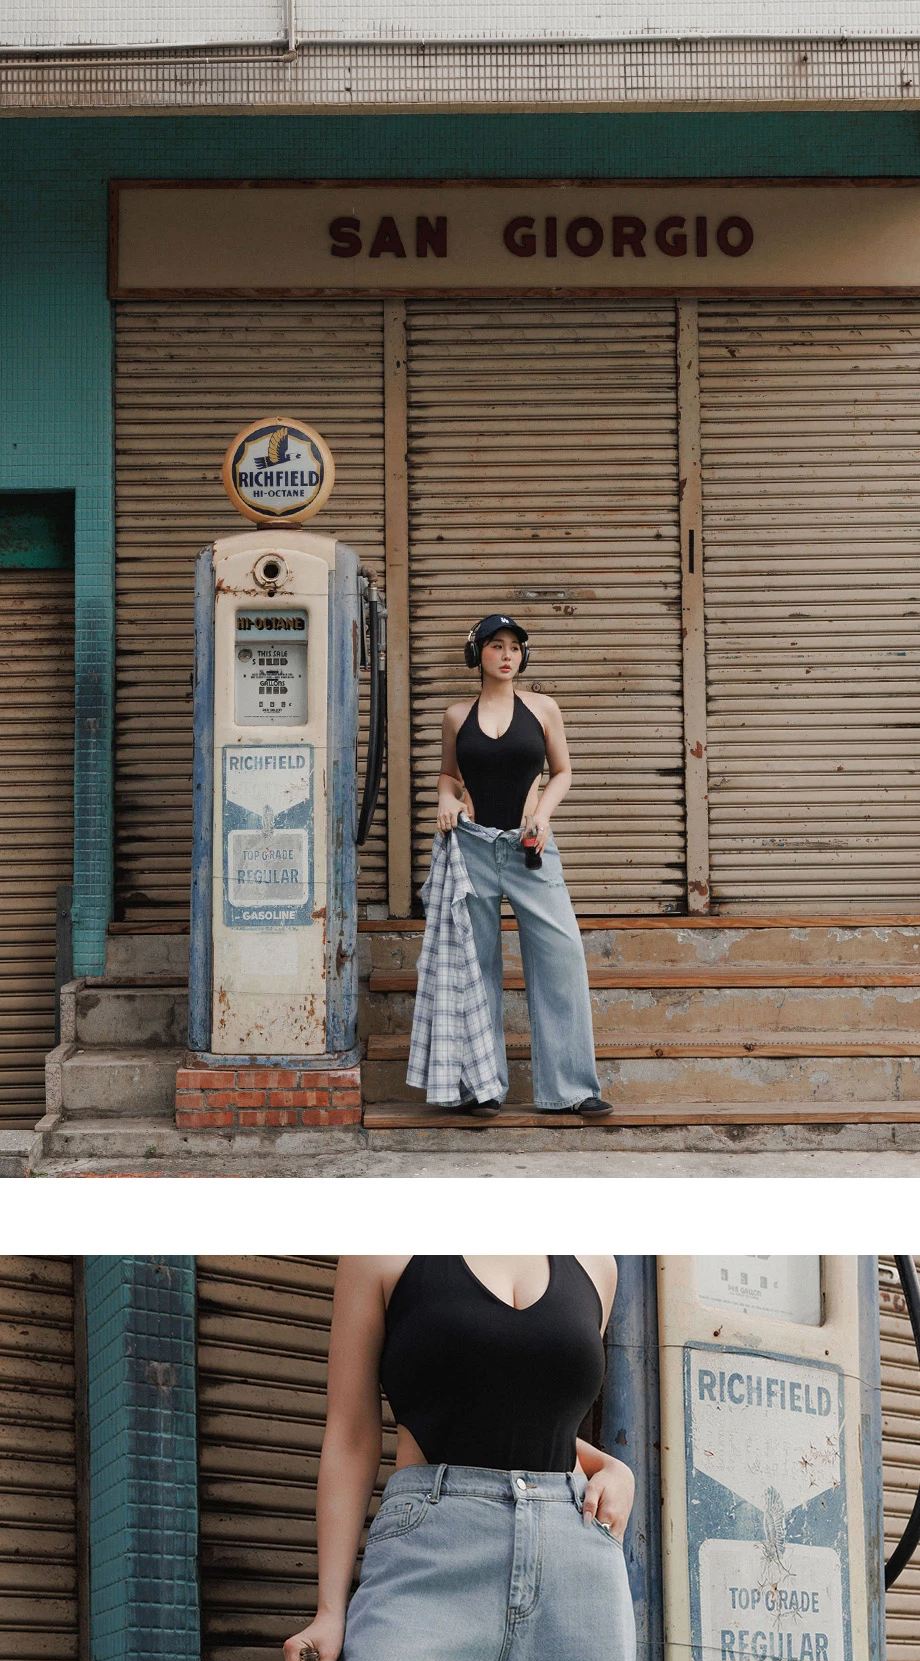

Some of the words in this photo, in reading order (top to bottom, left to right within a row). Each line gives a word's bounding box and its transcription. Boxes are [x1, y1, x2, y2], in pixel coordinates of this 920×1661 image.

[328, 215, 448, 258] SAN
[502, 215, 755, 258] GIORGIO
[239, 470, 320, 488] RICHFIELD
[253, 489, 305, 498] HI-OCTANE
[237, 617, 305, 631] HI-OCTANE
[229, 755, 306, 771] RICHFIELD
[242, 850, 260, 861] TOP
[261, 850, 294, 861] GRADE
[237, 869, 300, 885] REGULAR
[242, 910, 297, 921] GASOLINE
[698, 1369, 832, 1418] RICHFIELD
[729, 1587, 761, 1610] TOP
[765, 1589, 820, 1613] GRADE
